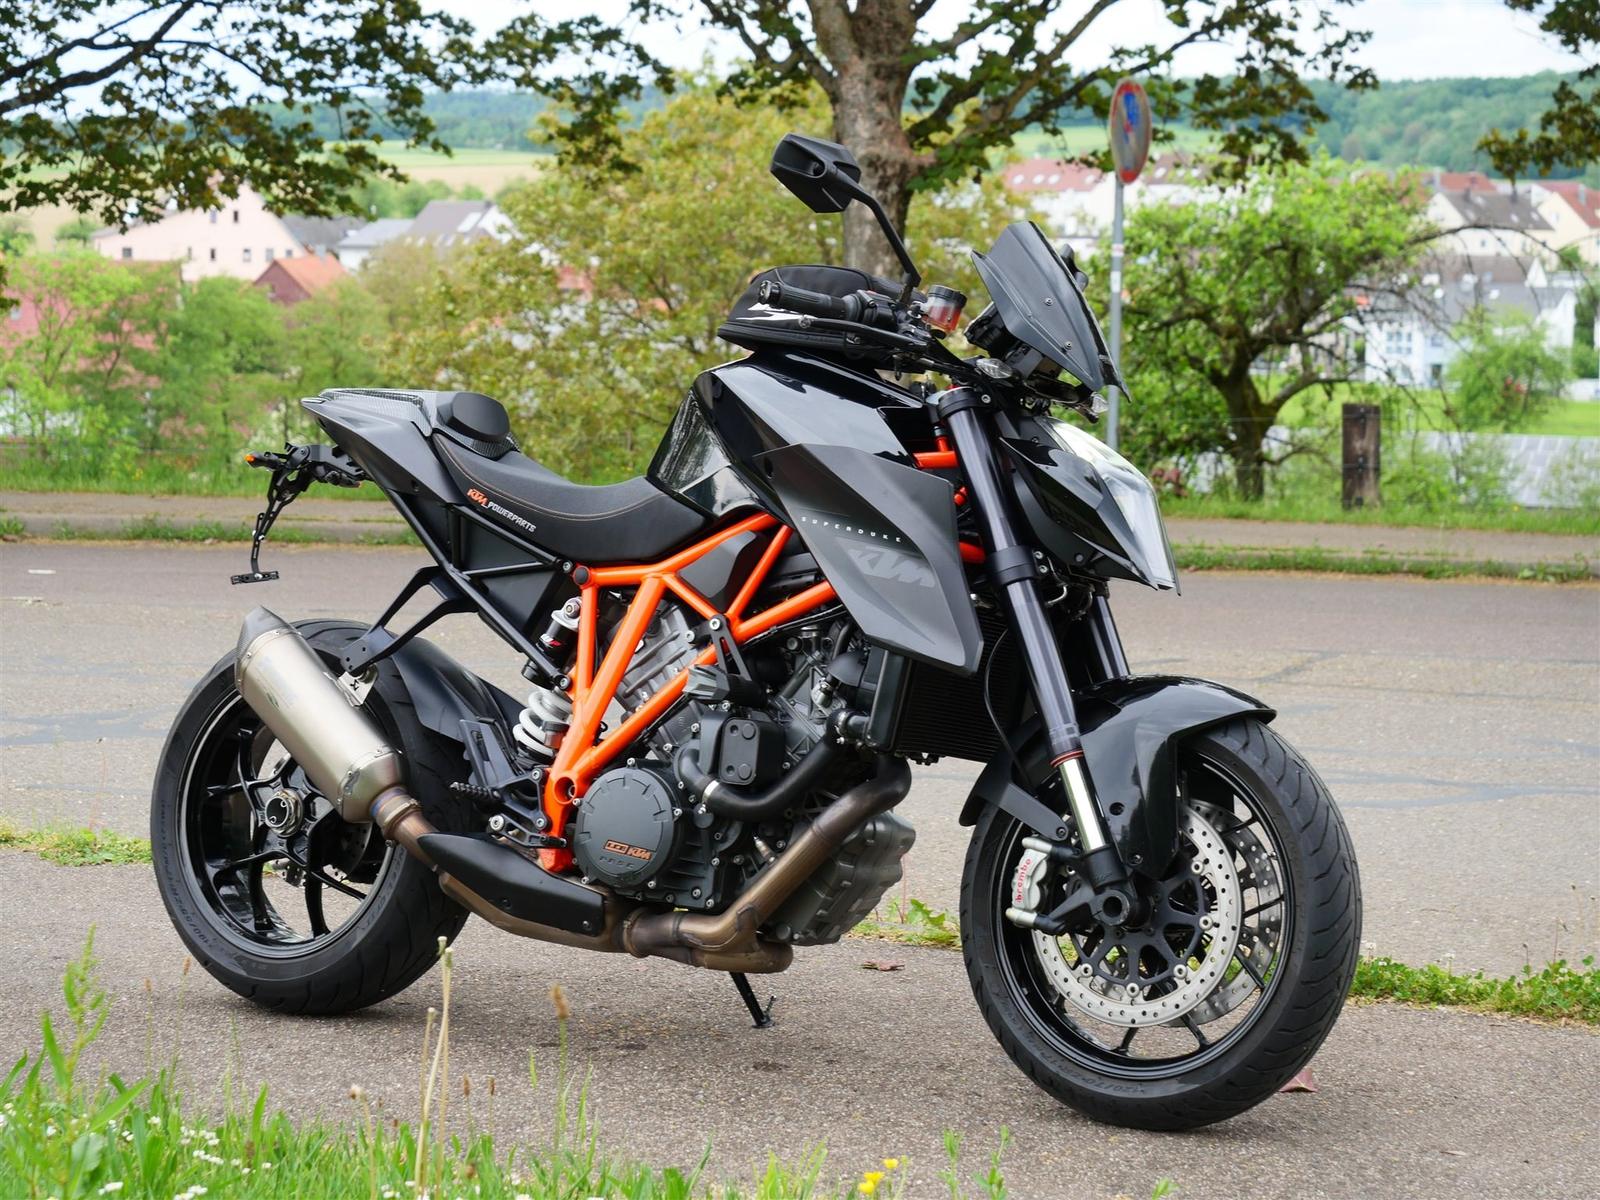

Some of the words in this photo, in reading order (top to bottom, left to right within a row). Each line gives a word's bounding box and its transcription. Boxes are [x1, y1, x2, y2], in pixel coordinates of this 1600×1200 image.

[467, 488, 489, 505] KTM
[483, 501, 537, 533] POWERPARTS
[848, 545, 935, 588] KTM
[628, 847, 652, 860] KTM
[1015, 858, 1032, 903] brembo
